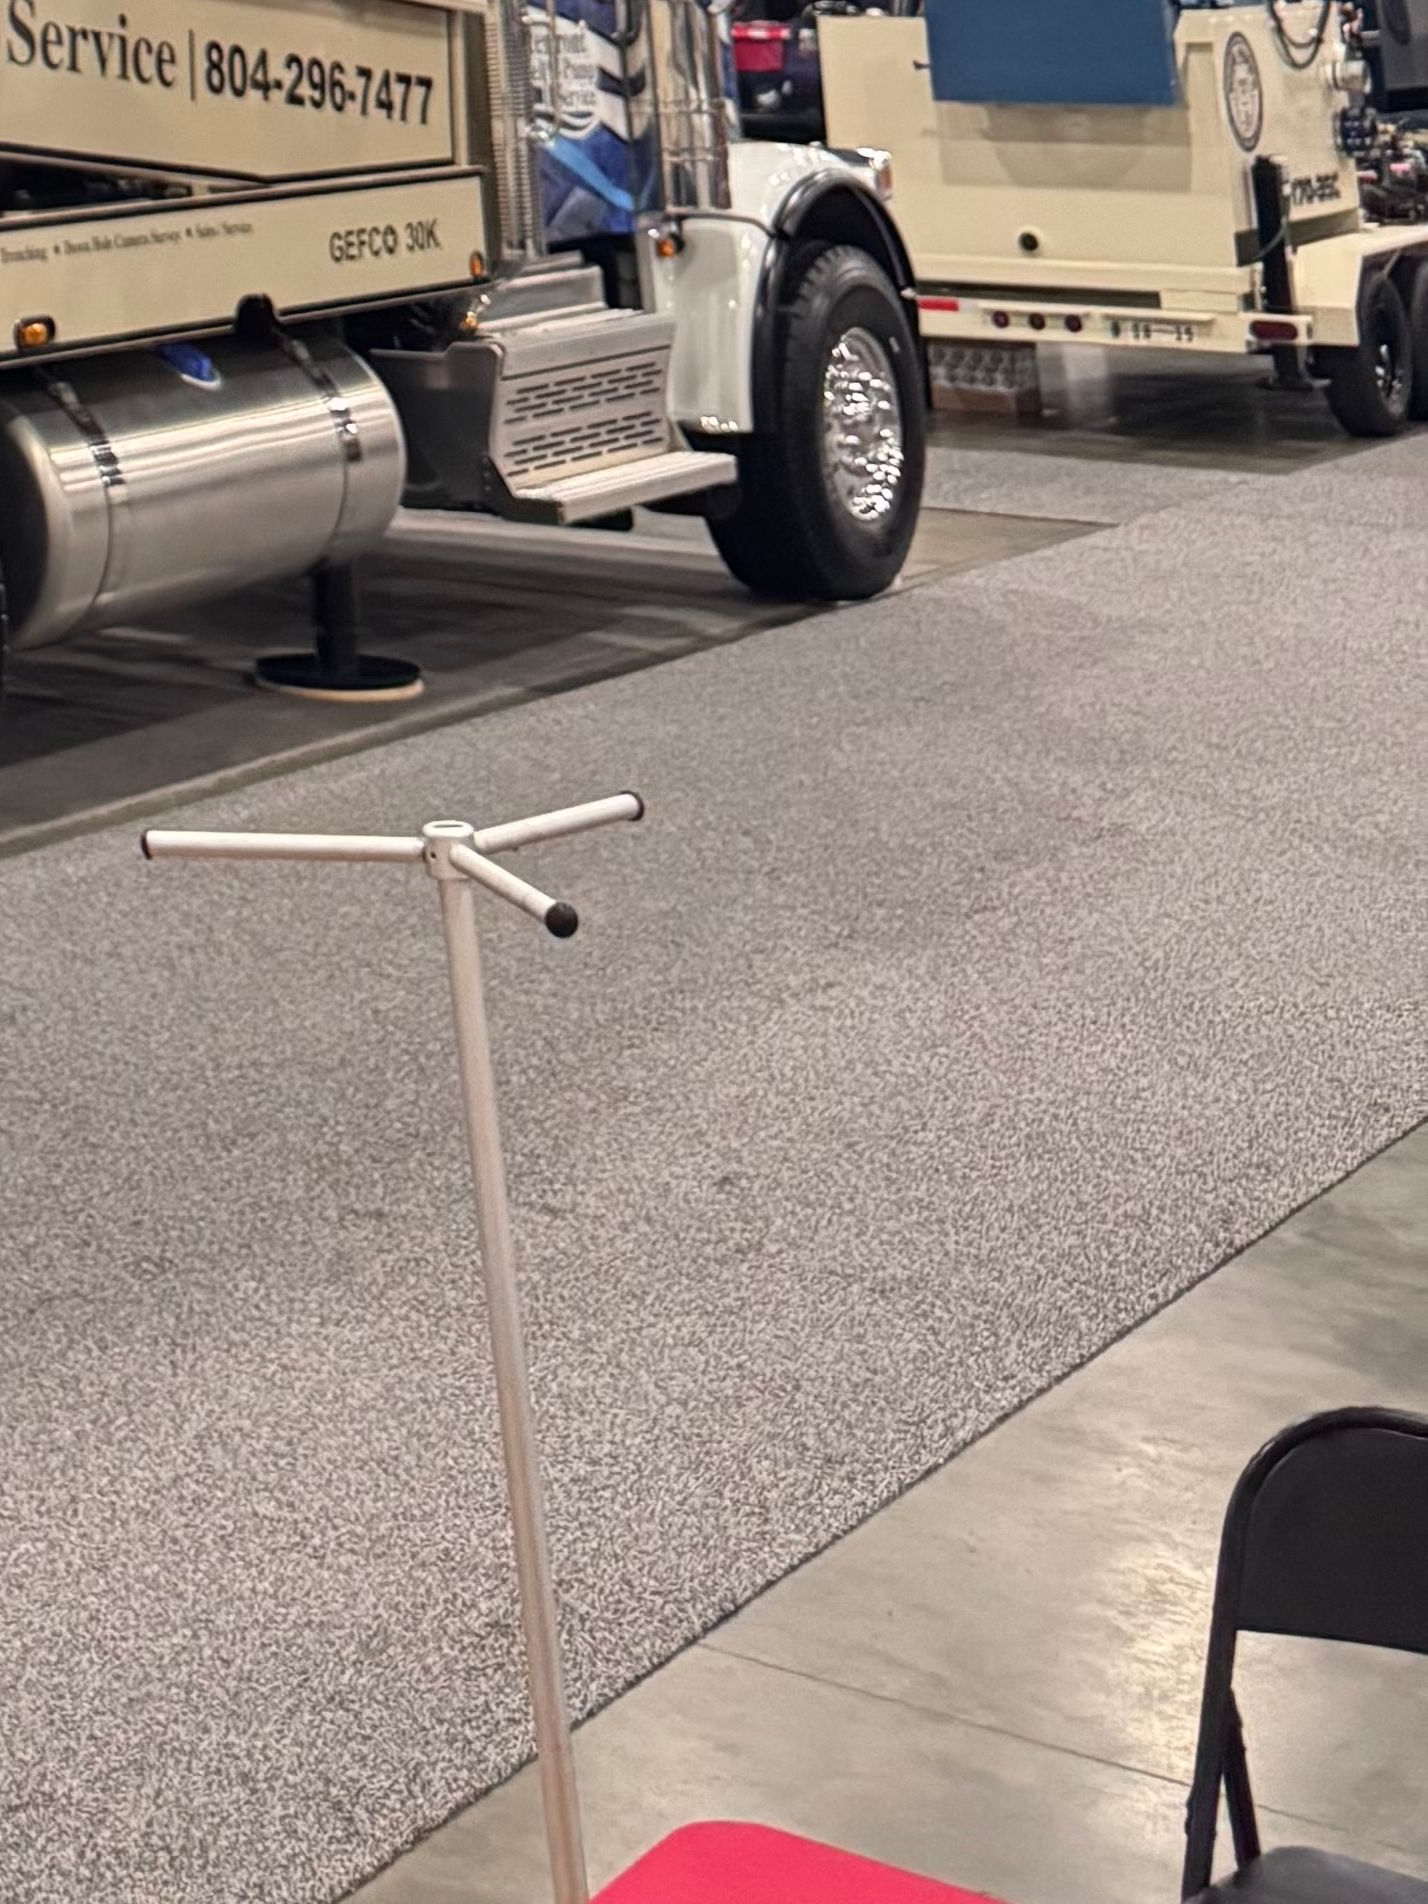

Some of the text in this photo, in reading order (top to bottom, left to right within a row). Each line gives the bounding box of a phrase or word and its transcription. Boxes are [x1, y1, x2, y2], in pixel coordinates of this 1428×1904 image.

[204, 40, 434, 126] 804-296-7477
[328, 218, 442, 264] GEFCO 30K
